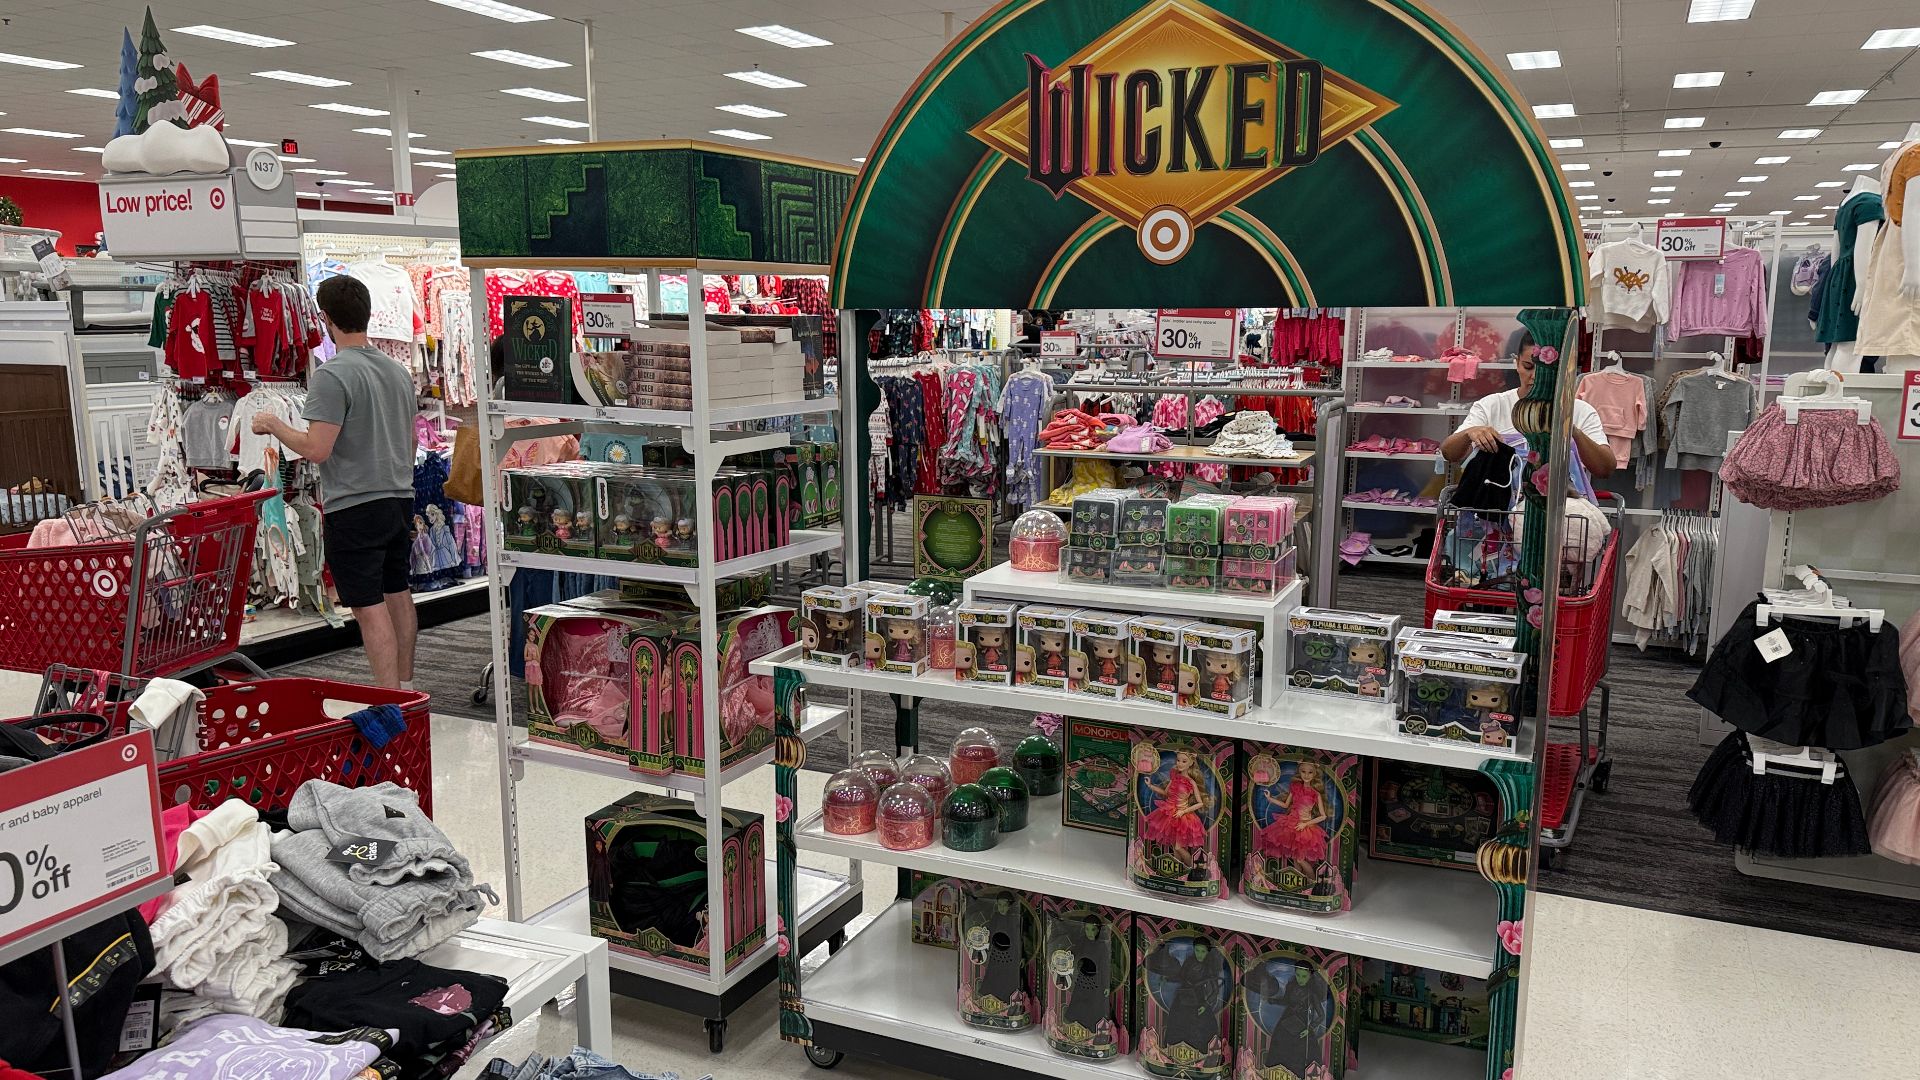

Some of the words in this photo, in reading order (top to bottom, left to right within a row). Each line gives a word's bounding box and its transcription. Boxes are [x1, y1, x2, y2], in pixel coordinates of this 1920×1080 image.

[1023, 52, 1324, 200] WICKED
[285, 143, 296, 152] EXIT
[254, 162, 275, 173] N37
[106, 192, 140, 214] Low
[145, 189, 193, 217] price!
[1661, 236, 1683, 251] 30
[586, 312, 603, 328] 30
[1162, 328, 1187, 349] 30
[1189, 332, 1197, 341] %
[1189, 341, 1201, 349] off
[512, 338, 558, 361] WICKED
[1043, 343, 1054, 352] 30
[536, 534, 561, 549] WICKED
[635, 543, 662, 557] WICKED
[1313, 621, 1336, 629] ELPHABA
[1428, 660, 1456, 669] ELPHABA
[1464, 663, 1487, 673] GLINDA
[8, 813, 30, 829] and
[33, 803, 60, 820] baby
[63, 788, 102, 809] apparel
[342, 844, 359, 856] art
[369, 842, 378, 861] class
[26, 844, 57, 877] %
[1153, 858, 1184, 874] WICKED
[32, 863, 72, 899] off
[1274, 871, 1308, 887] WICKED
